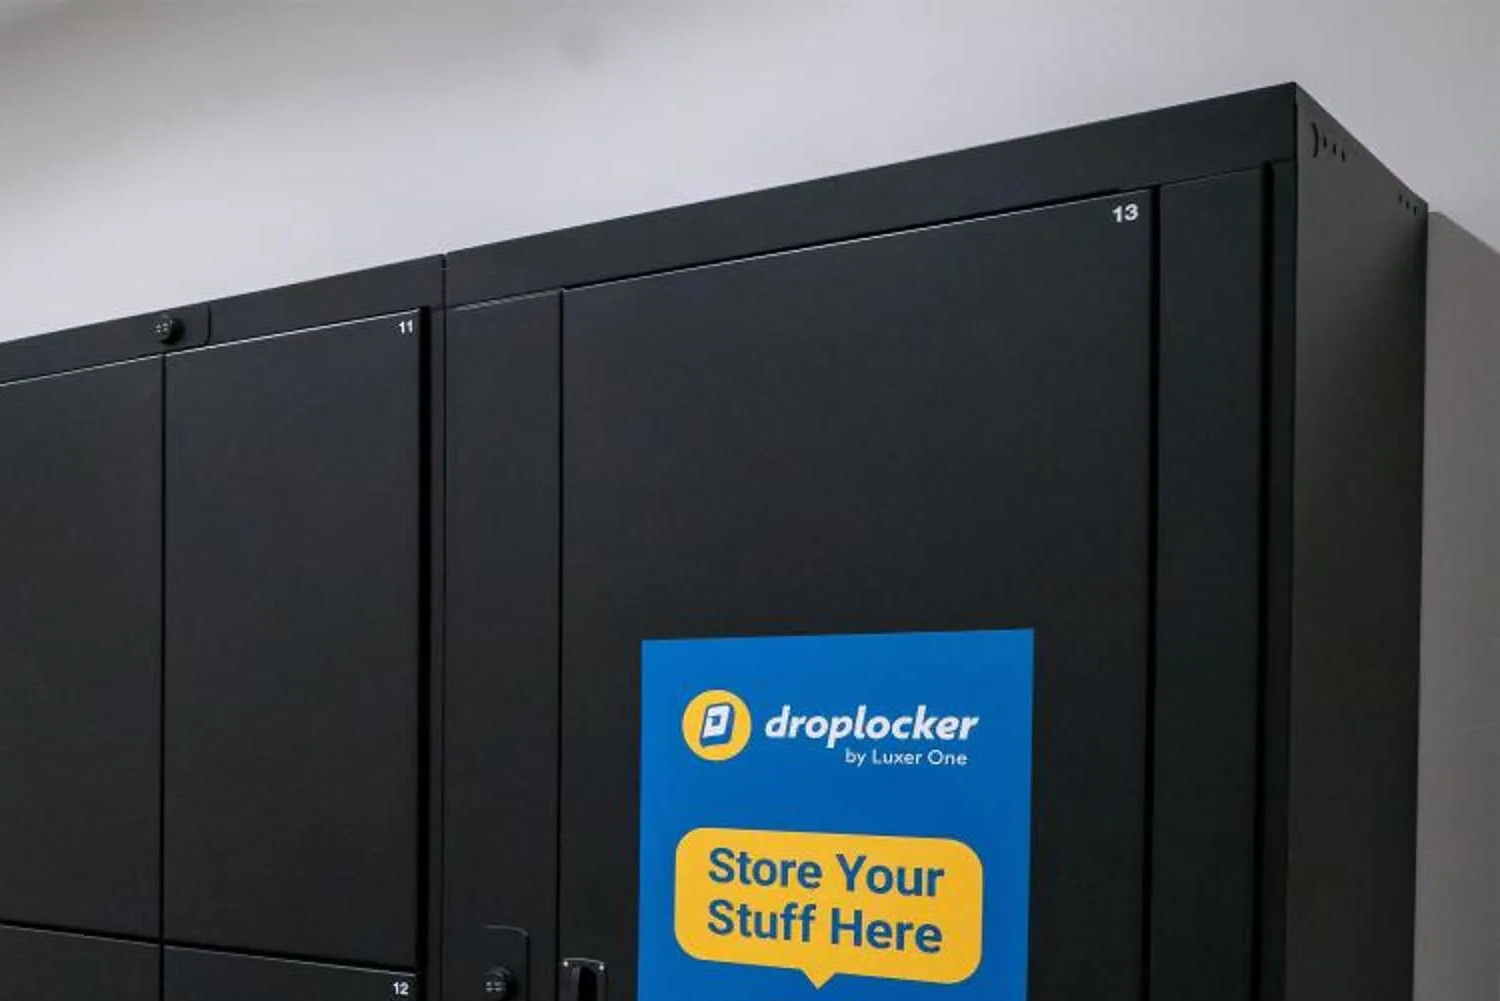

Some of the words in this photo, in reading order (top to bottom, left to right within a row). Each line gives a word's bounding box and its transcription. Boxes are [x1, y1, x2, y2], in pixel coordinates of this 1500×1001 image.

[1111, 203, 1139, 223] 13
[398, 319, 413, 334] 11
[764, 704, 980, 750] droplocker
[844, 748, 867, 768] by
[872, 748, 923, 766] Luxer
[927, 749, 969, 767] One
[707, 846, 823, 890] Store
[835, 853, 945, 898] Your
[706, 898, 817, 944] Stuff
[830, 907, 944, 955] Here
[393, 981, 409, 995] 12
